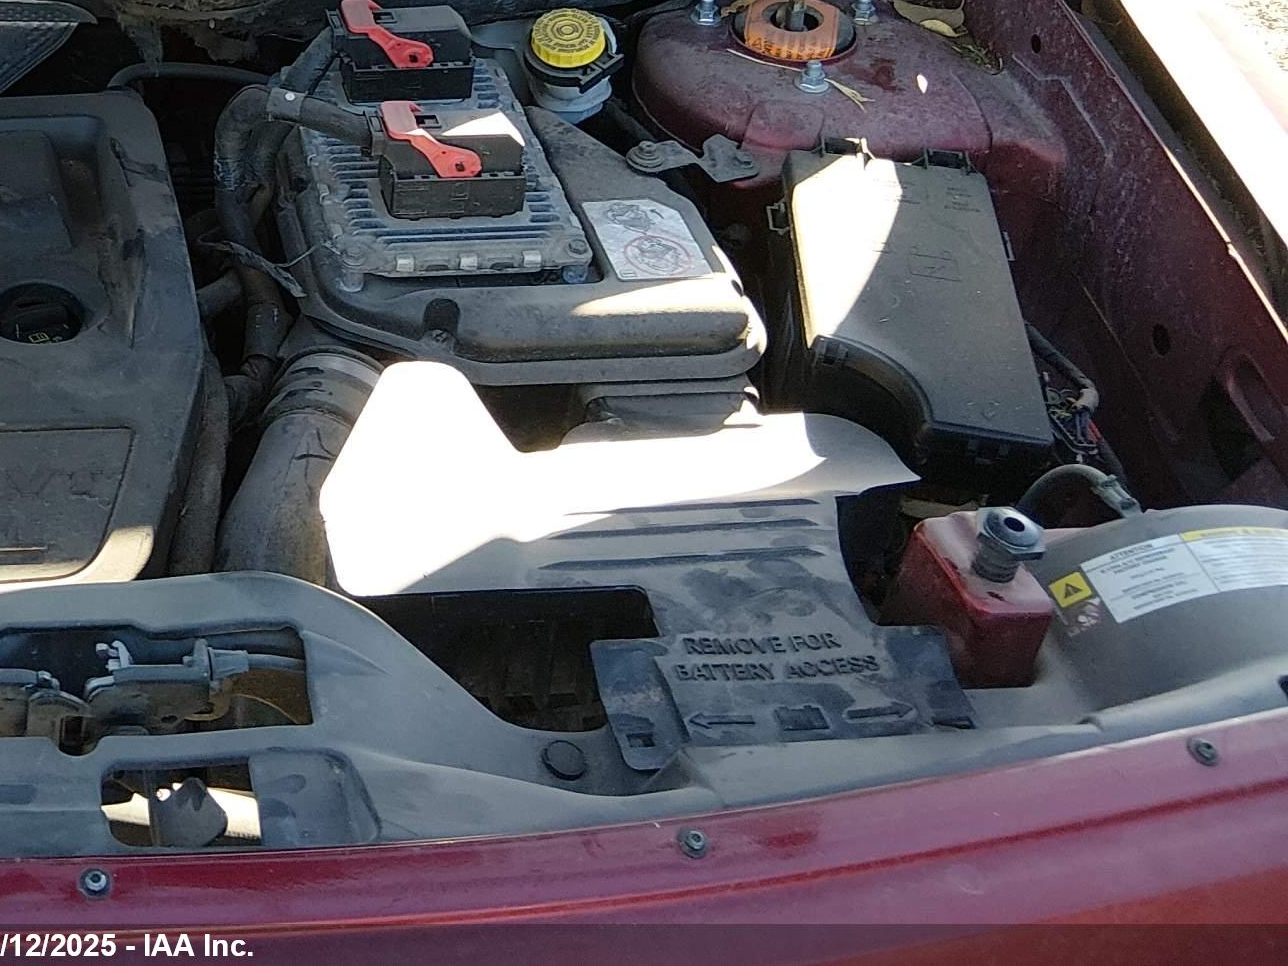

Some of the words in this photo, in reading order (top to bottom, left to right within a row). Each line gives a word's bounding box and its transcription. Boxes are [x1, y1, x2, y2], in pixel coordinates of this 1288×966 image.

[681, 636, 788, 656] REMOVE
[791, 632, 842, 653] FOR
[672, 662, 778, 683] BATTERY
[785, 654, 881, 680] ACCESS
